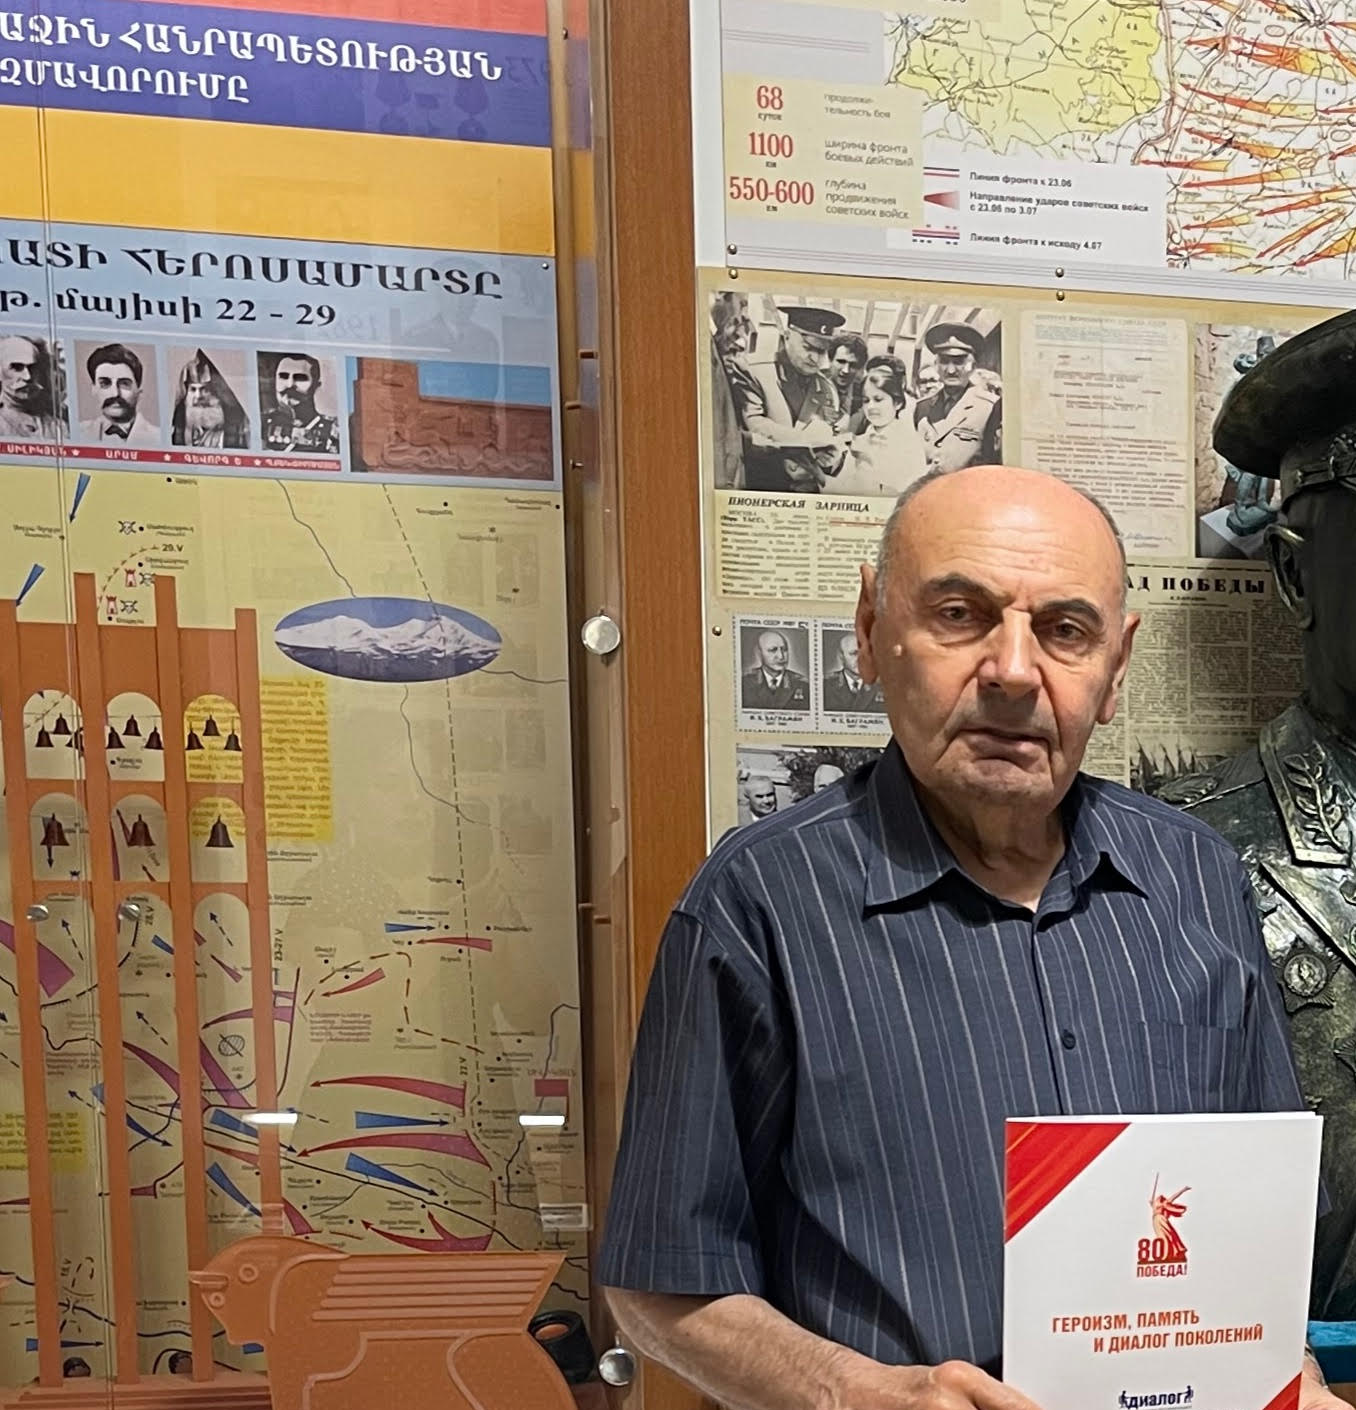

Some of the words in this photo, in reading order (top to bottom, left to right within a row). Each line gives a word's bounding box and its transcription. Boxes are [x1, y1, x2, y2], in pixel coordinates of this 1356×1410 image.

[119, 22, 502, 80] ՀԱՆՐԱՊԵՏՈՒԹՅԱՆ
[756, 85, 784, 110] 68
[749, 132, 794, 158] 1100
[824, 139, 867, 152] ширина
[869, 142, 908, 154] фронта
[865, 155, 915, 167] действий
[1002, 175, 1038, 187] фронта
[729, 176, 814, 205] 550-600
[879, 208, 910, 220] войск
[1004, 206, 1017, 214] по
[1002, 235, 1038, 247] фронта
[0, 238, 108, 270] ԱՏԻ
[121, 247, 503, 299] ՀԵՐՈՍԱՄԱՐՏԸ
[56, 288, 202, 325] մայիսի
[216, 297, 256, 321] 22
[295, 303, 336, 326] 29
[106, 450, 139, 460] ԱՐԱՄ
[727, 496, 806, 509] ПИОНЕРСКАЯ
[815, 501, 870, 513] ЗАРНИЦА
[1162, 577, 1265, 594] ПОБЕДЫ
[1137, 1238, 1166, 1262] 80
[1137, 1264, 1188, 1278] ПОБЕДА!
[1052, 1313, 1132, 1334] ГЕРОИЗМ,
[1137, 1309, 1200, 1329] ПАМЯТЬ
[1093, 1337, 1104, 1353] И
[1108, 1332, 1170, 1354] ДИАЛОГ
[1175, 1324, 1264, 1348] ПОКОЛЕНИЙ
